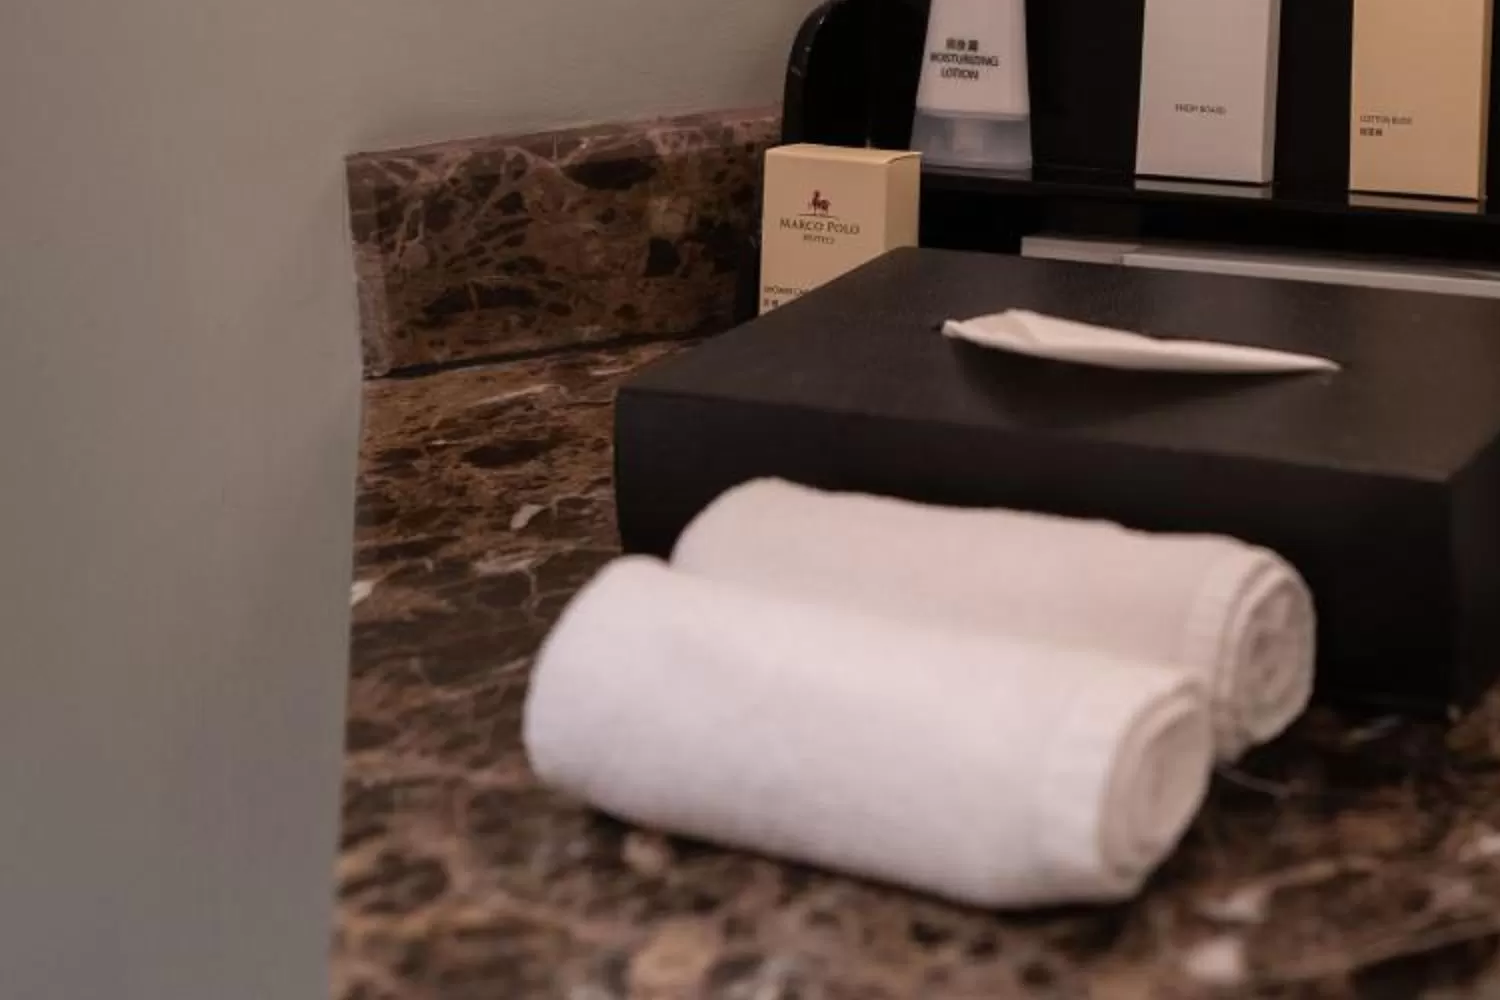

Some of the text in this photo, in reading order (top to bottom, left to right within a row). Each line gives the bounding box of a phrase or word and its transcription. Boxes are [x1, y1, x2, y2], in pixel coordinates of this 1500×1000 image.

[941, 67, 979, 80] LOTION
[780, 217, 860, 236] MARCO POLO
